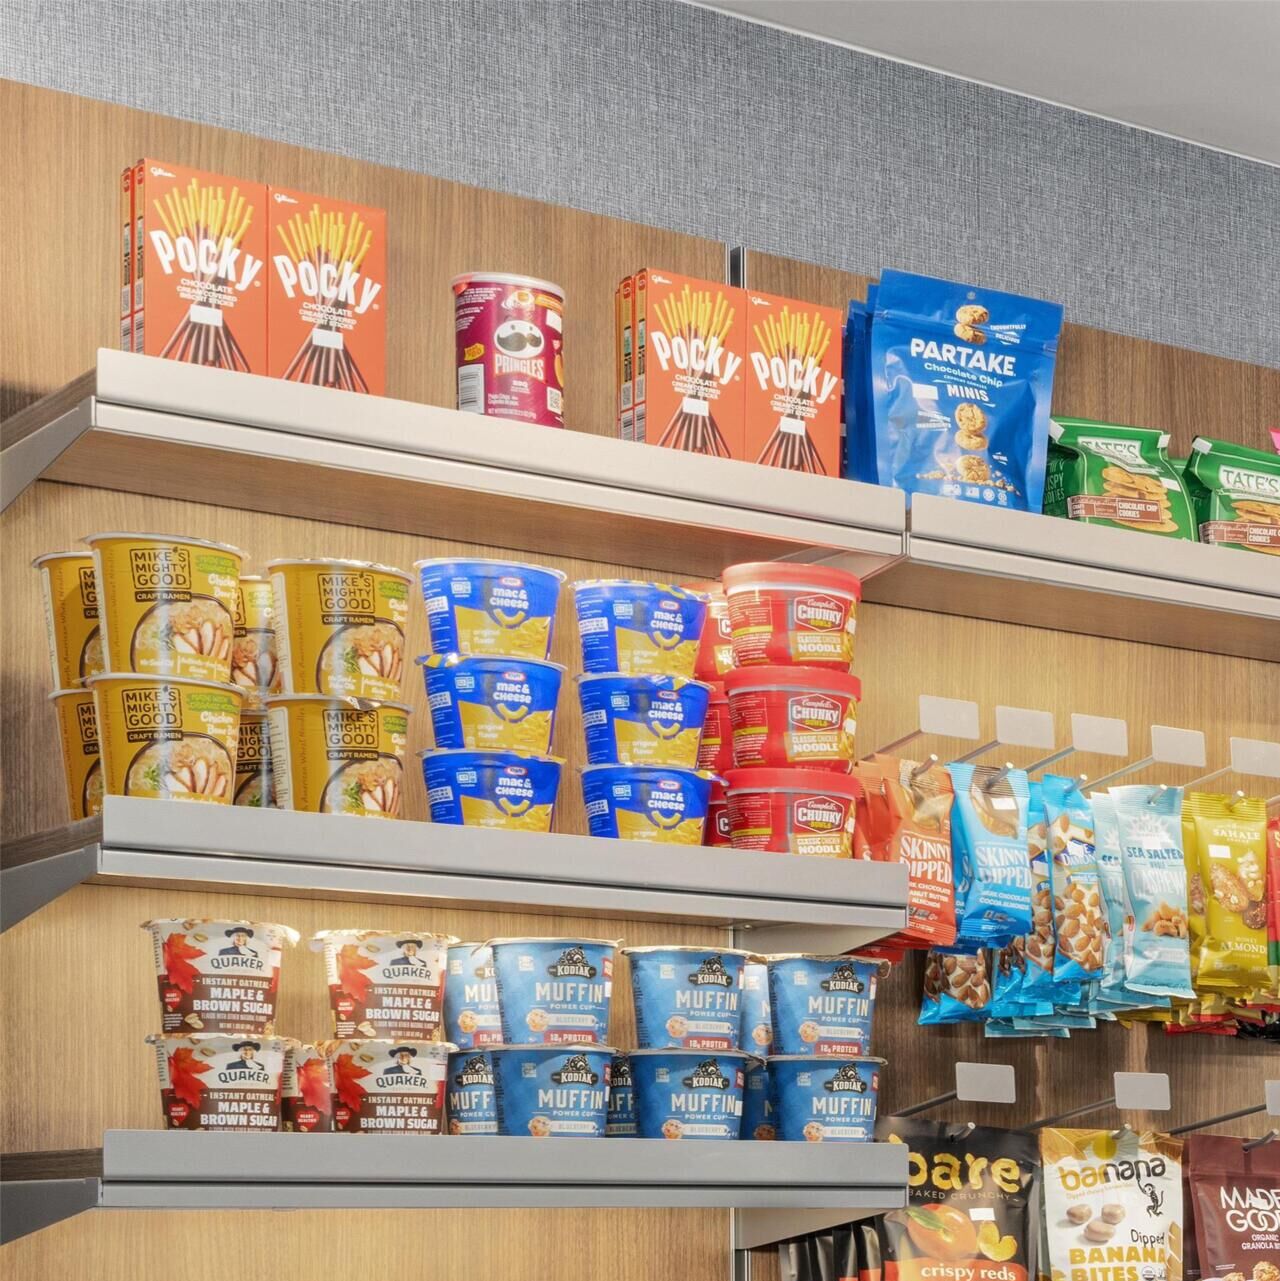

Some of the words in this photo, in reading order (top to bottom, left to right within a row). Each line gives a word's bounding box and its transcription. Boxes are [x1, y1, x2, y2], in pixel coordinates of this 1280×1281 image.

[495, 353, 545, 381] PRINGLES
[924, 362, 978, 381] Chocolate
[979, 373, 1003, 388] Chip
[947, 382, 988, 402] MINIS
[1223, 467, 1280, 493] TATE'S
[134, 549, 186, 561] MIKE'S
[135, 562, 187, 574] MIGHTY
[137, 575, 187, 587] GOOD
[136, 592, 159, 600] CRAFT
[161, 592, 190, 601] RAMEN
[493, 586, 514, 599] mac
[797, 605, 842, 627] CHUNKY
[797, 643, 842, 655] NOODLE
[1213, 828, 1260, 840] SAHALE
[977, 846, 1031, 866] SKINNY
[979, 867, 1032, 889] DIPPED
[211, 957, 263, 969] QUAKER
[558, 965, 590, 977] KODIAK
[210, 988, 253, 1000] MAPLE
[254, 990, 264, 1000] &
[536, 983, 603, 1003] MUFFIN
[193, 1000, 239, 1011] BROWN
[242, 1002, 272, 1014] SUGAR
[898, 1143, 1020, 1192] bare
[1069, 1248, 1165, 1264] BANANA
[921, 1264, 975, 1281] crispy
[980, 1267, 1016, 1281] reds
